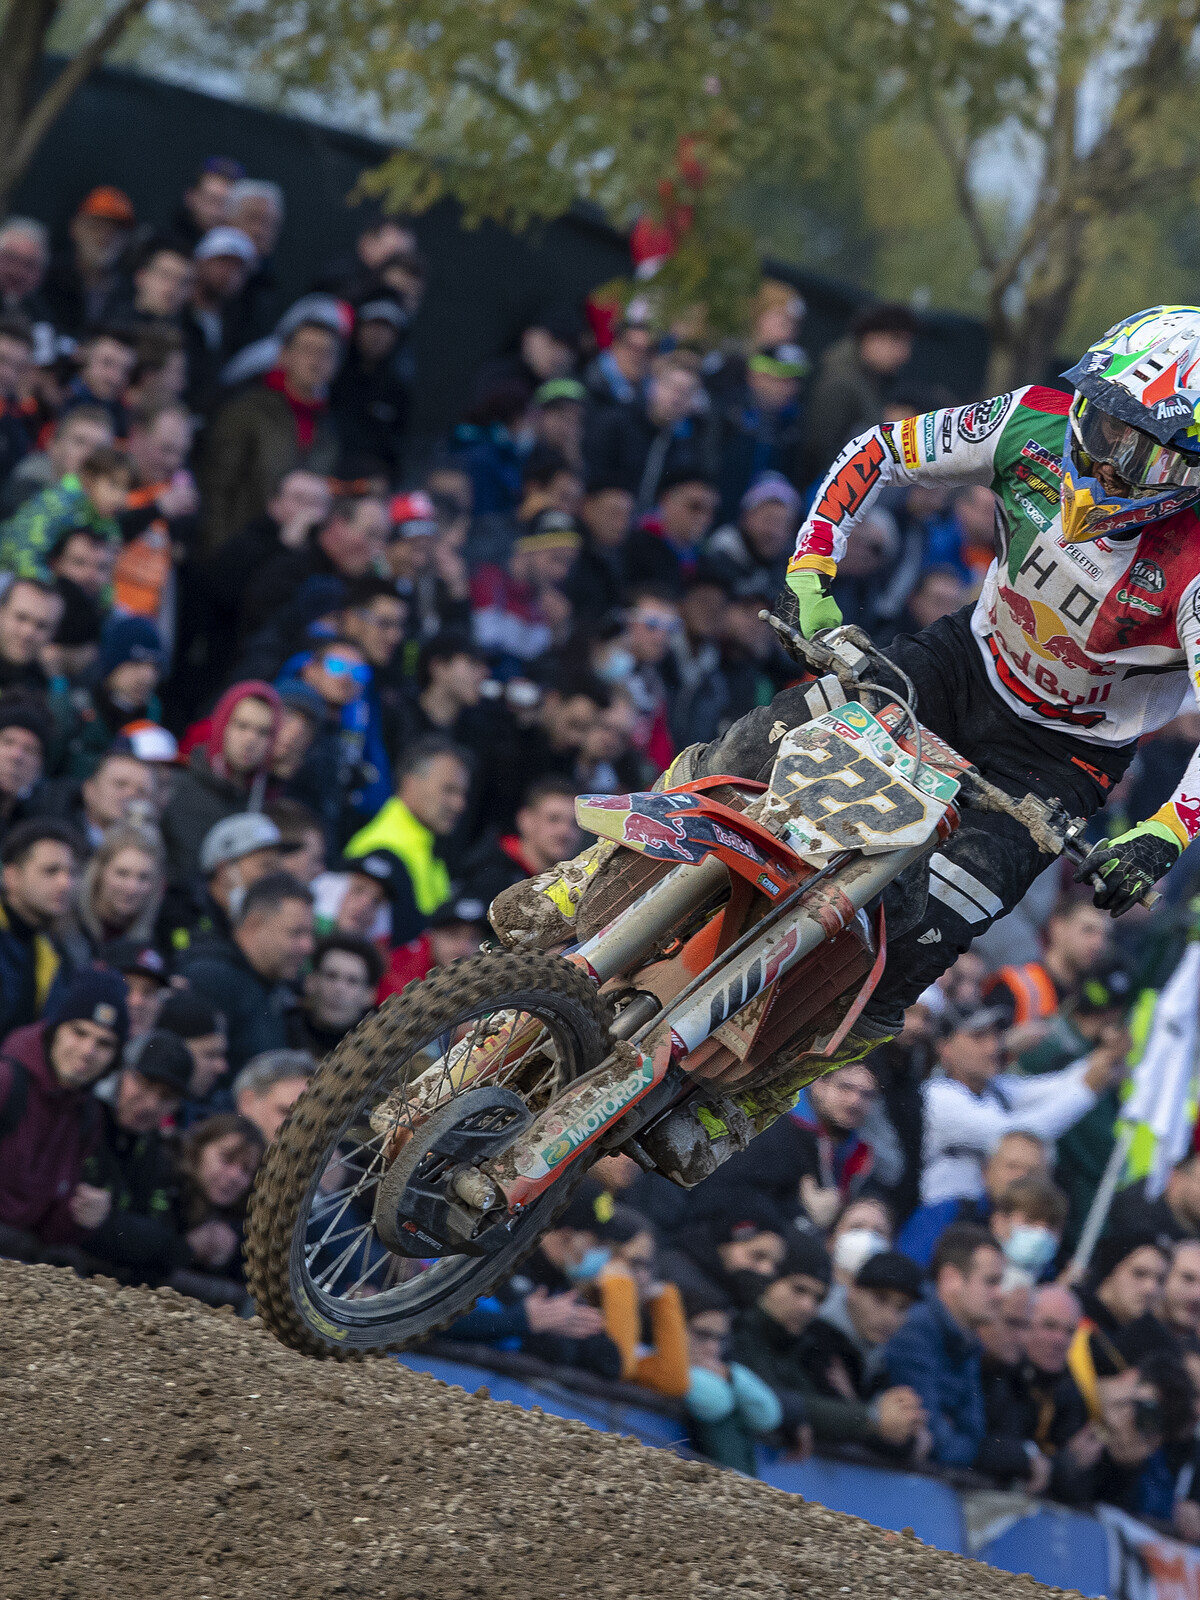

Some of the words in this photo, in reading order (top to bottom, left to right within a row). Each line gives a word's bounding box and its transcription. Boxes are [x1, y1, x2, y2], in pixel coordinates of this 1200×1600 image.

[1157, 397, 1192, 420] Airoh
[925, 413, 935, 457] MOTOREX
[942, 414, 952, 454] SIDI
[815, 434, 886, 527] KTM
[1066, 544, 1098, 575] PELETTO
[1132, 561, 1162, 588] Airoh
[1035, 663, 1113, 706] Bull
[818, 716, 862, 741] MXGP
[770, 733, 928, 849] 222
[567, 1067, 652, 1145] MOTOREX
